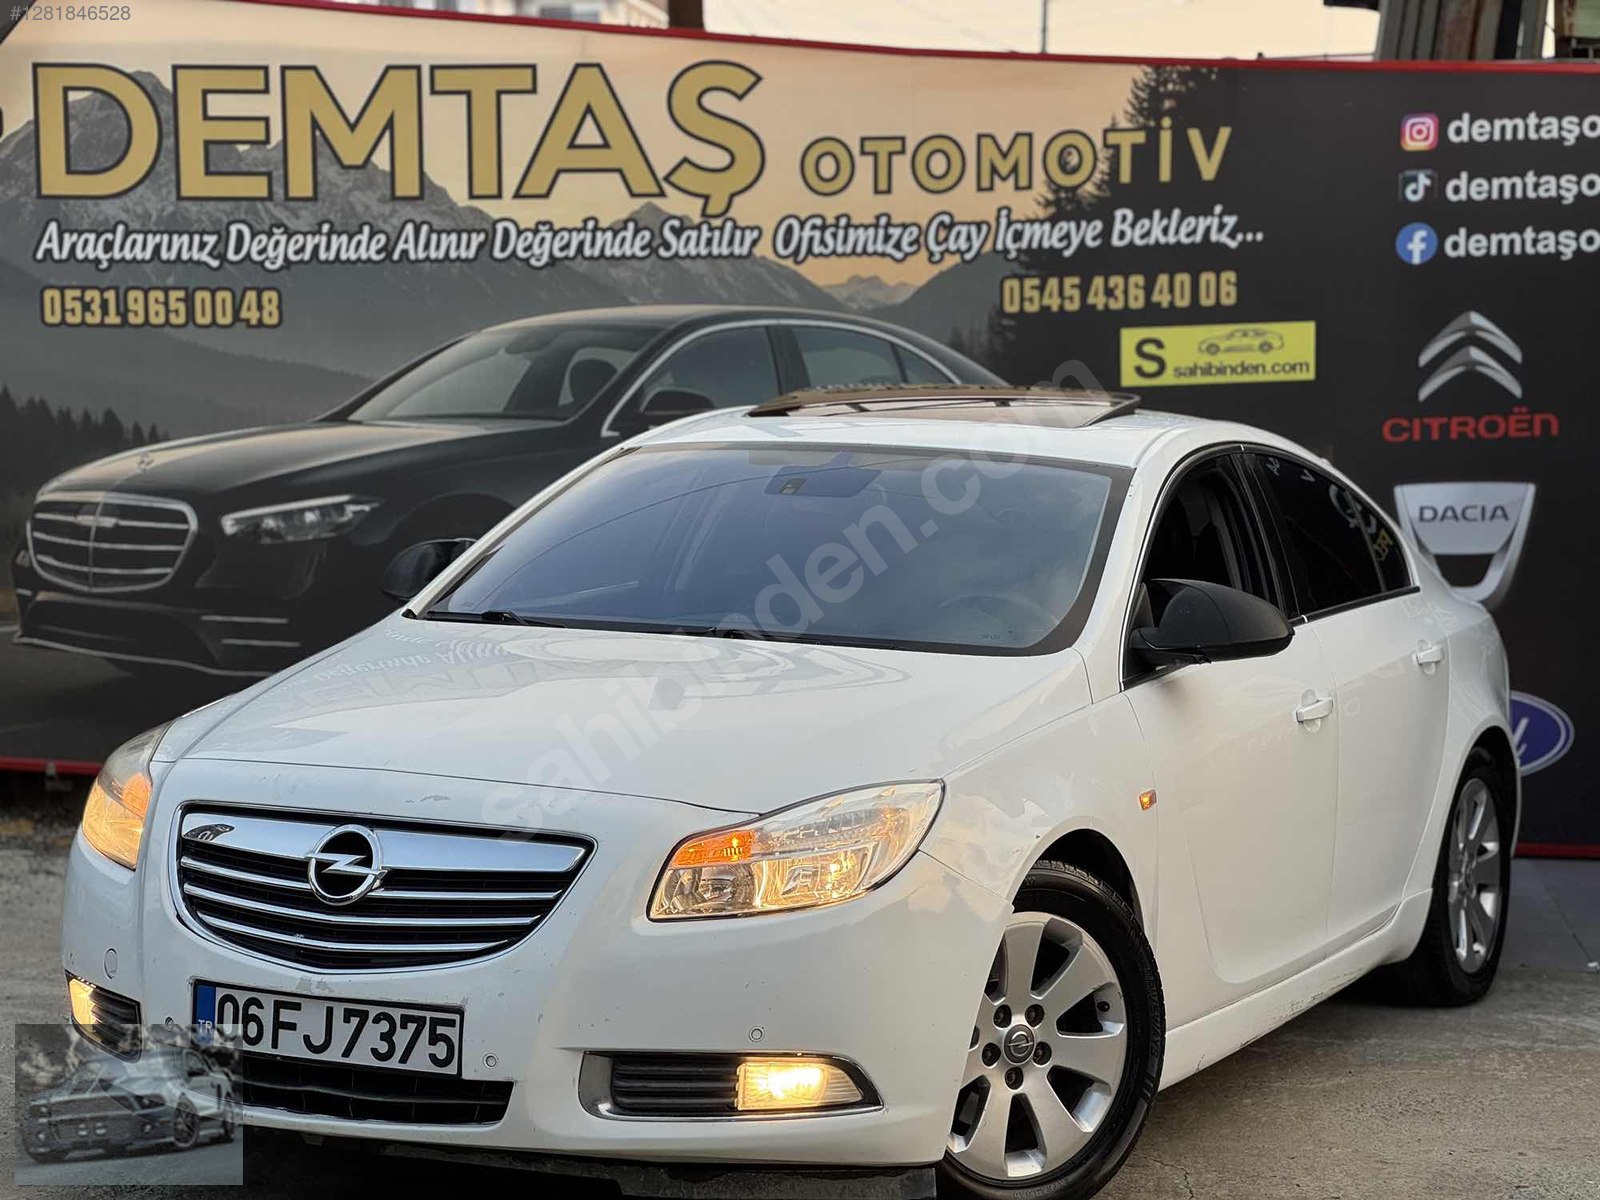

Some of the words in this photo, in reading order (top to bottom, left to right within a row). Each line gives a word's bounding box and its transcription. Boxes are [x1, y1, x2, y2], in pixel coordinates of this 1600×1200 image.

[32, 60, 765, 217] DEMTAŞ
[800, 117, 1232, 196] OTOMOTİV
[34, 220, 222, 270] Araçlarınız
[225, 222, 388, 271] Değerinde
[391, 219, 486, 262] Alınır
[490, 218, 653, 268] Değerinde
[657, 217, 761, 260] Satılır
[774, 213, 919, 263] Ofisimize
[926, 211, 989, 263] Çay
[995, 206, 1103, 258] İçmeye
[1111, 204, 1264, 249] Bekleriz...
[41, 287, 122, 327] 0531
[125, 287, 188, 327] 965
[192, 287, 235, 327] 00
[238, 287, 283, 327] 48
[1002, 276, 1082, 315] 0545
[1086, 274, 1146, 313] 436
[1150, 272, 1192, 310] 40
[1198, 270, 1238, 308] 06
[1133, 336, 1167, 380] S
[1172, 360, 1310, 379] sahibinden.com
[1417, 503, 1510, 523] DACIA
[197, 1019, 214, 1033] TR
